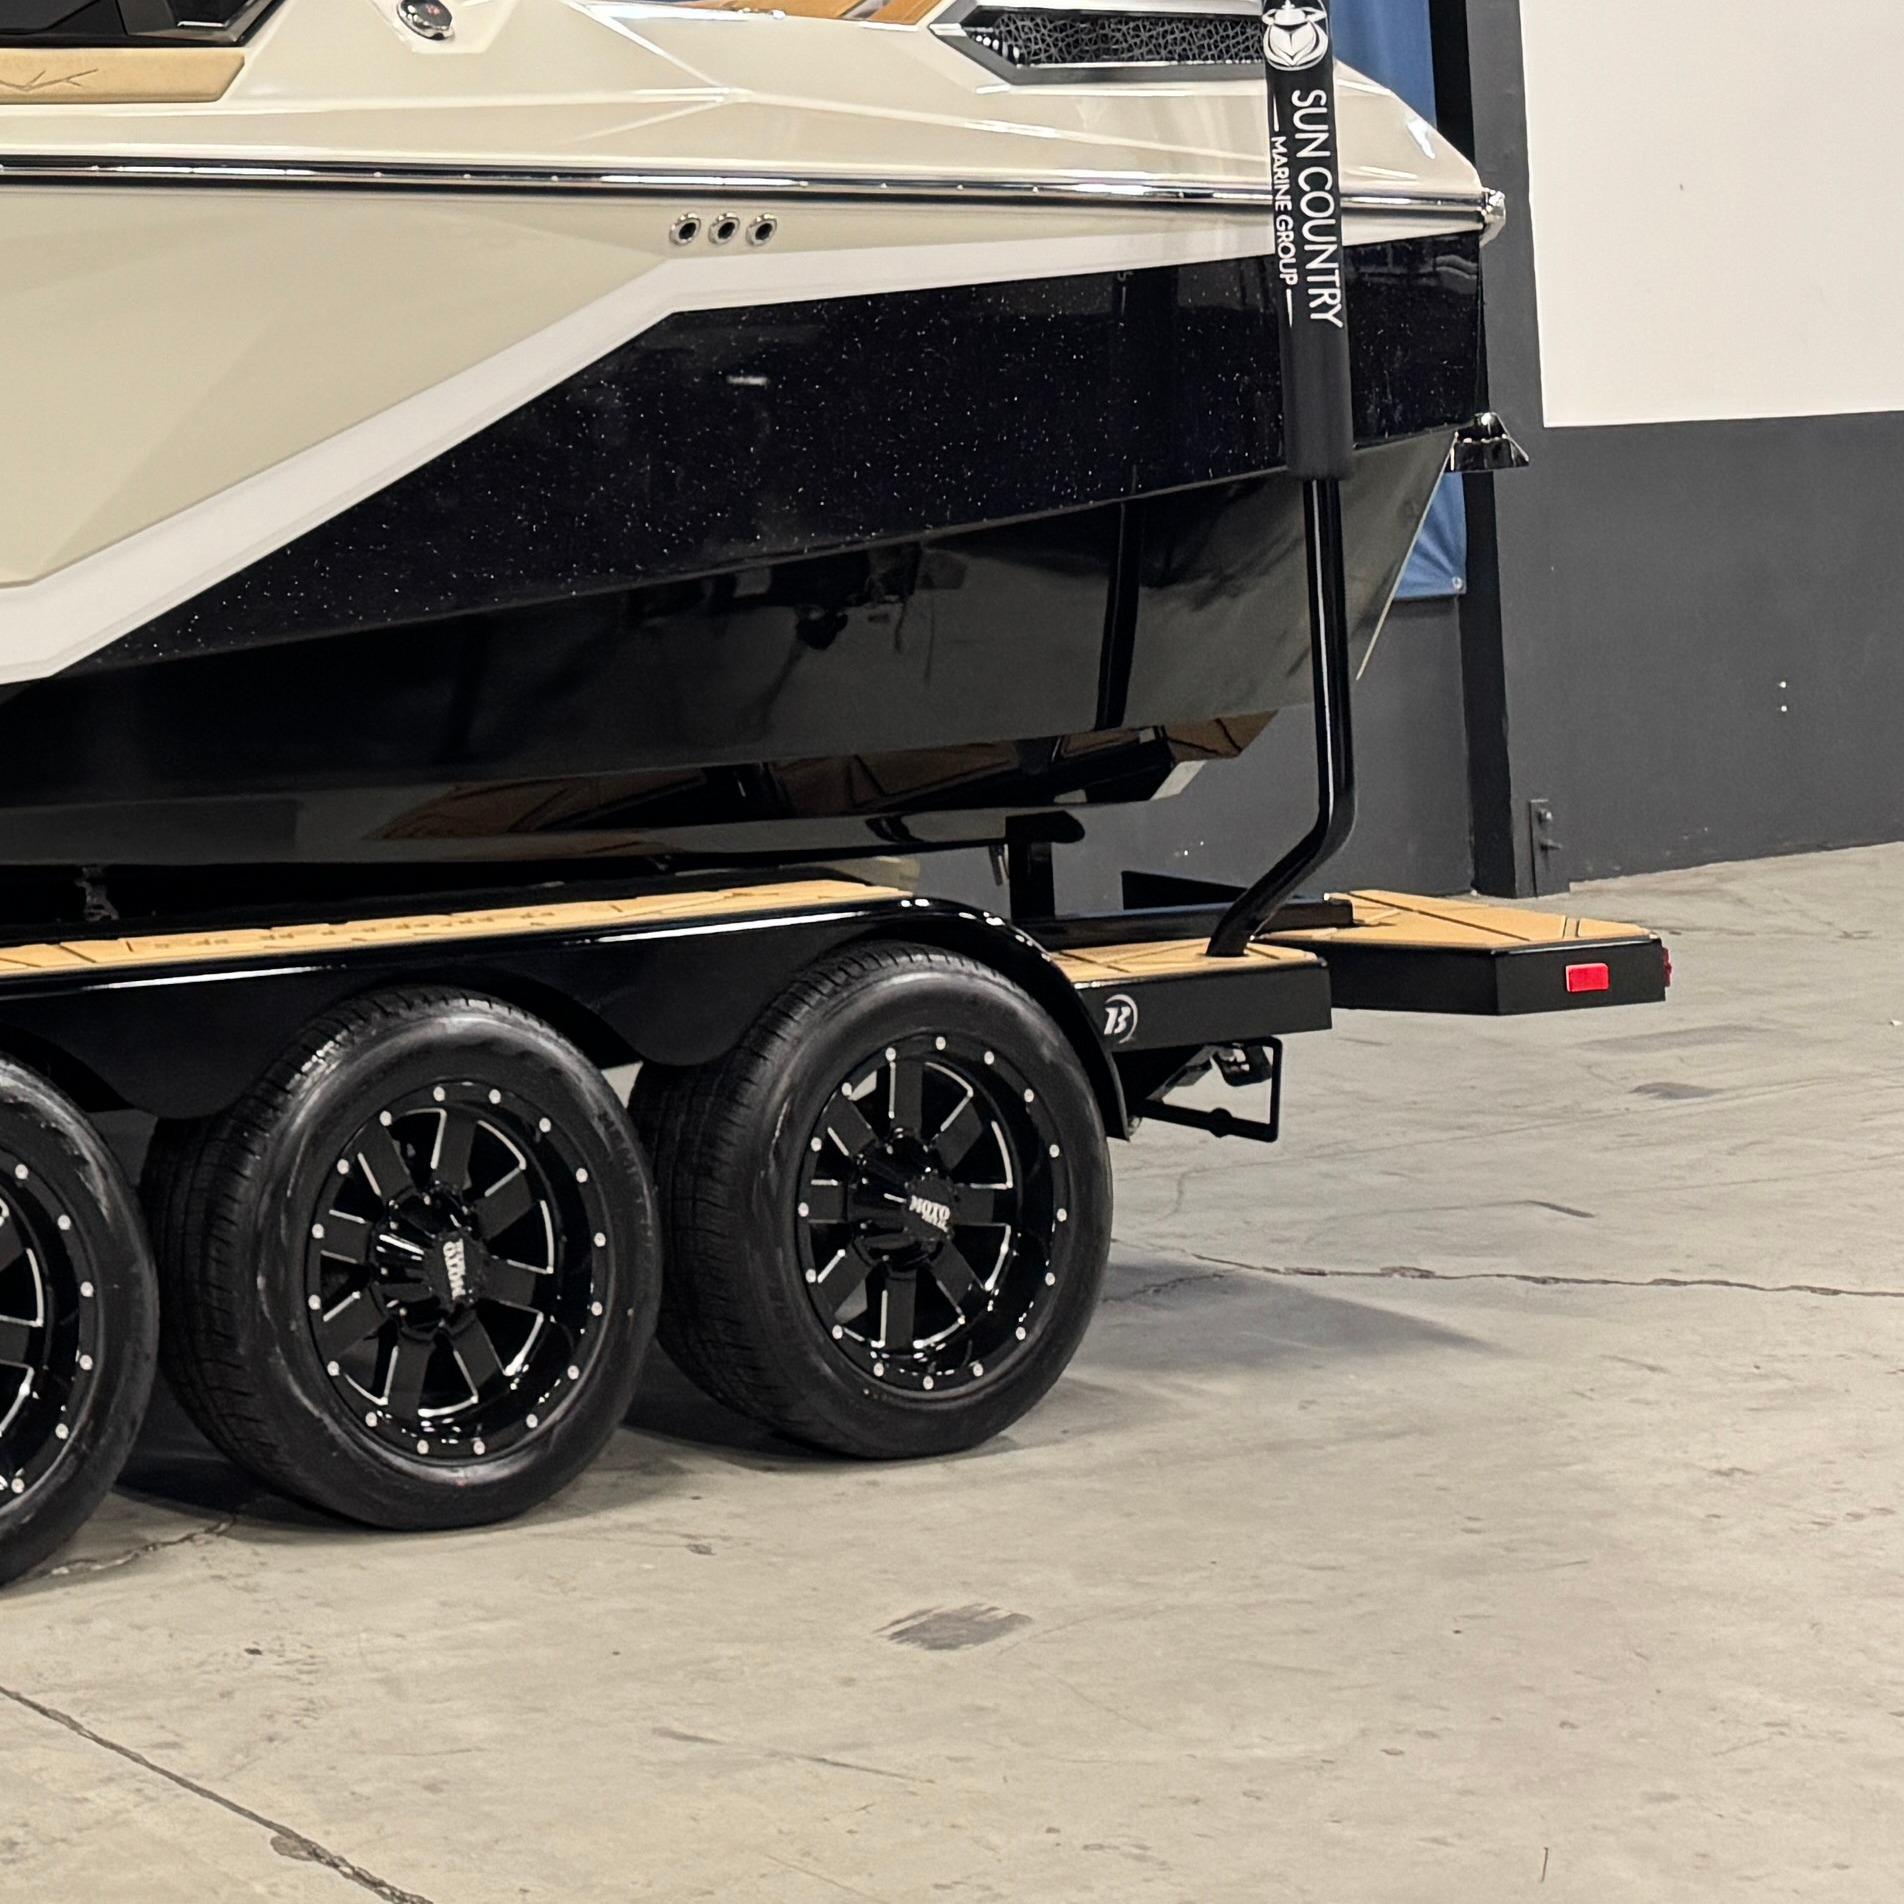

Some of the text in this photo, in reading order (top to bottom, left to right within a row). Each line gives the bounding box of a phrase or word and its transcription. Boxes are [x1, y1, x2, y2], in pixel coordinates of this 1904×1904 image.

[1271, 136, 1299, 286] MARINE GROUP
[1291, 89, 1343, 329] SUN COUNTRY
